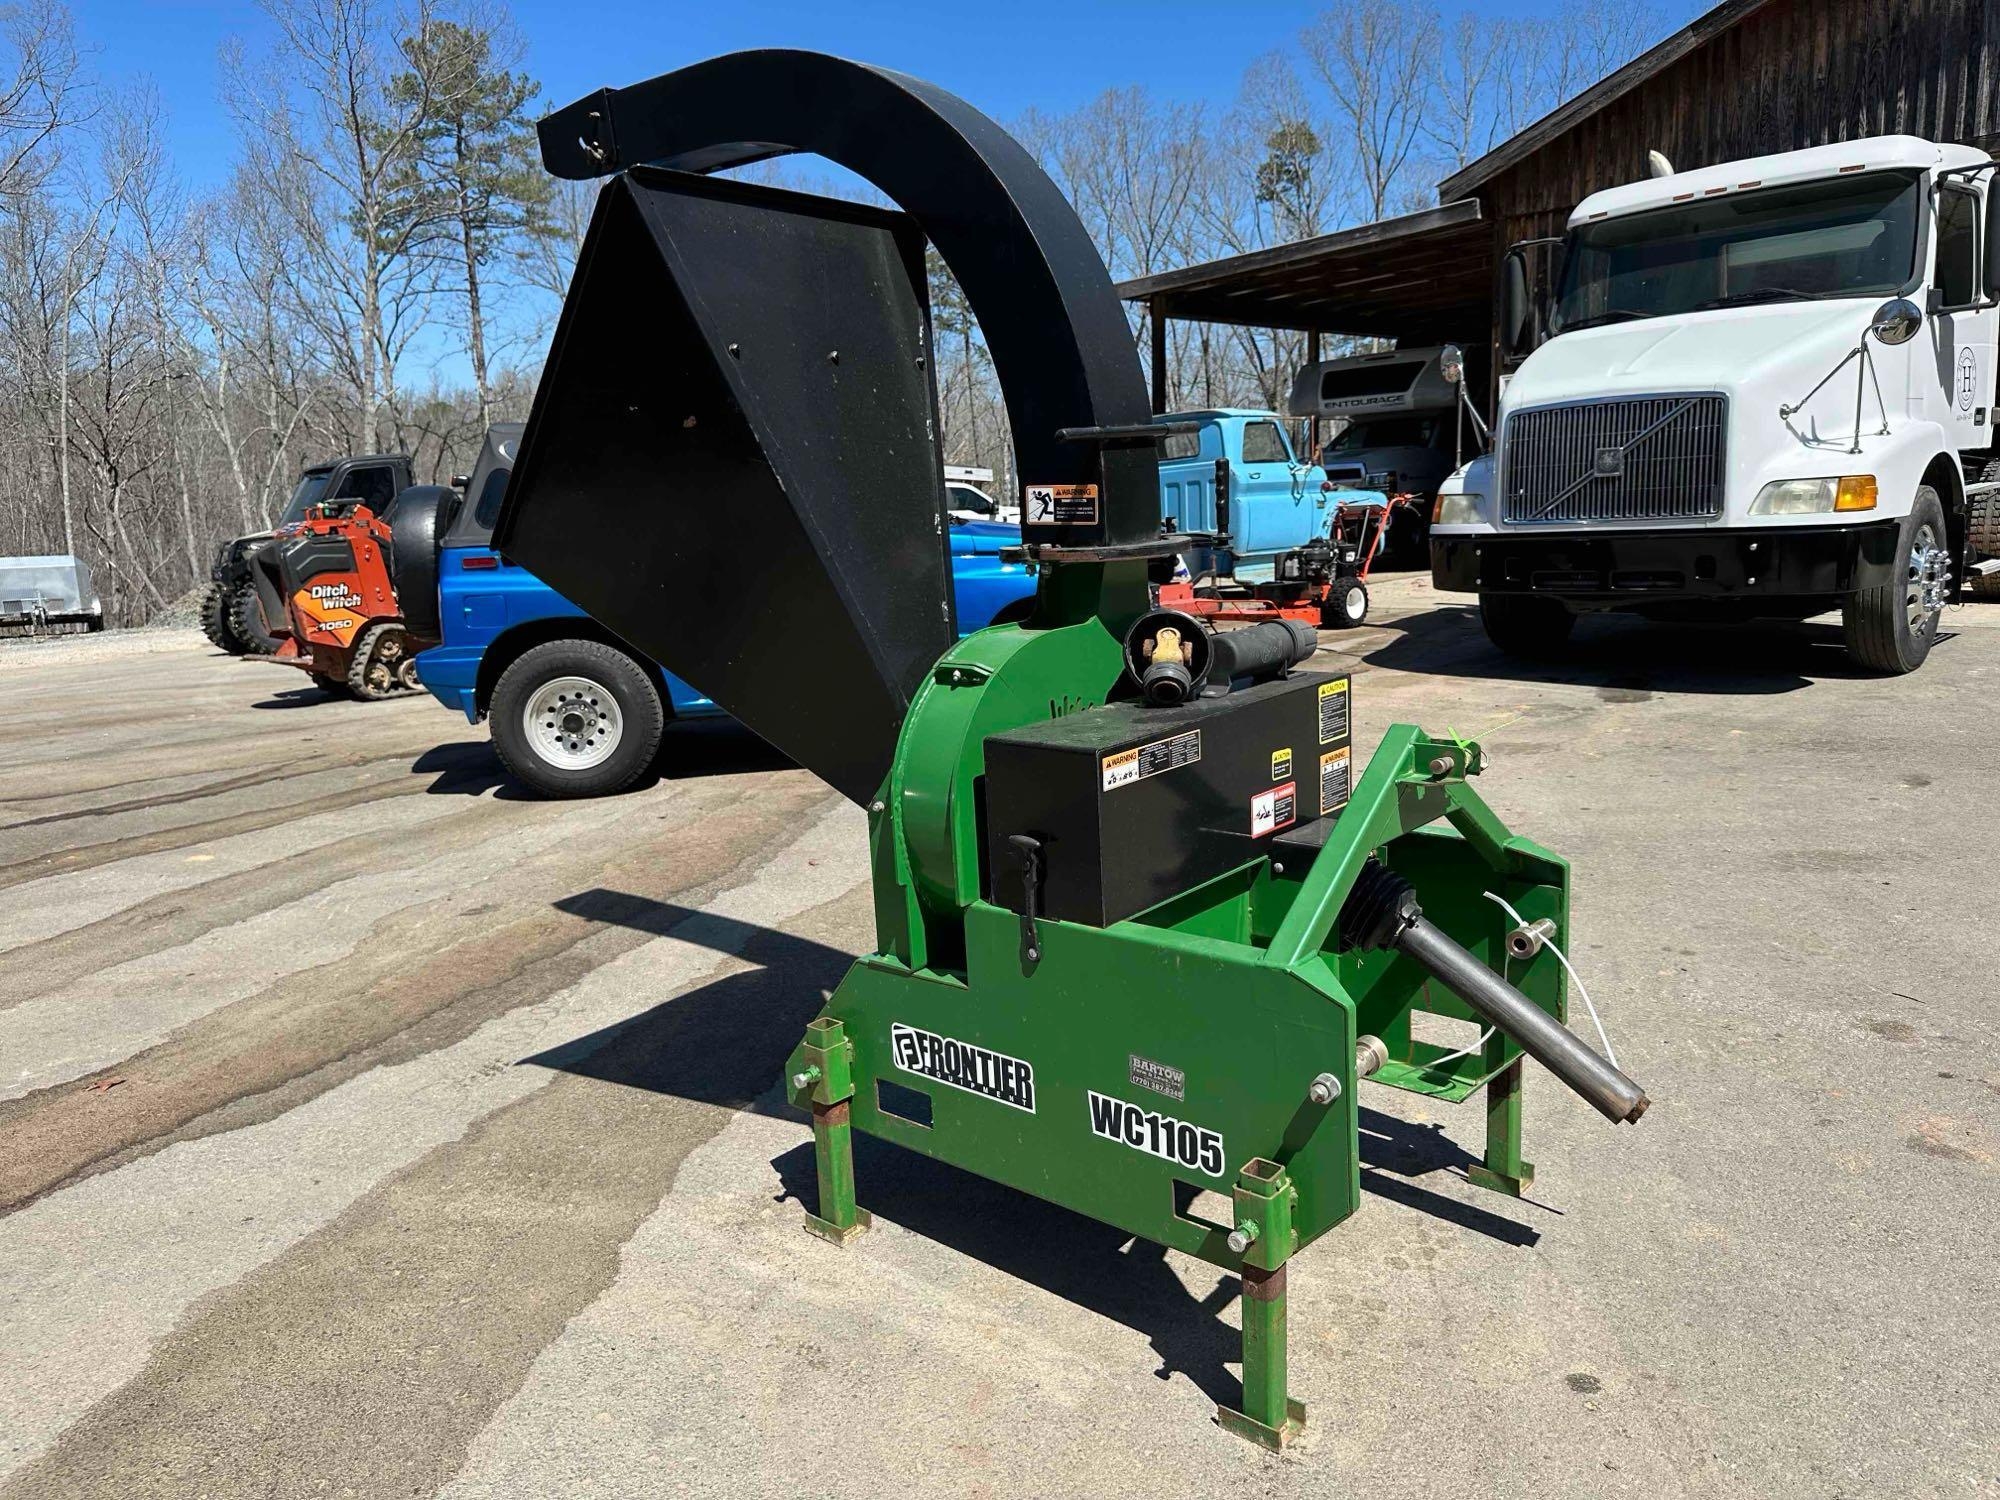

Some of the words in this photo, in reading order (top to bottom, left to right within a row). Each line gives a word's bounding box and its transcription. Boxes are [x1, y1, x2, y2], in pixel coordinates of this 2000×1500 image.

[1324, 395, 1405, 409] ENTOURAGE
[1060, 488, 1092, 496] WARNING
[312, 583, 348, 599] Ditch
[322, 594, 362, 610] Witch
[1111, 751, 1137, 766] WARNING
[914, 1030, 1033, 1100] FRONTIER
[1133, 1058, 1182, 1082] BARTOW
[924, 1066, 1027, 1106] EQUIPMENT
[1091, 1094, 1222, 1174] WC1105
